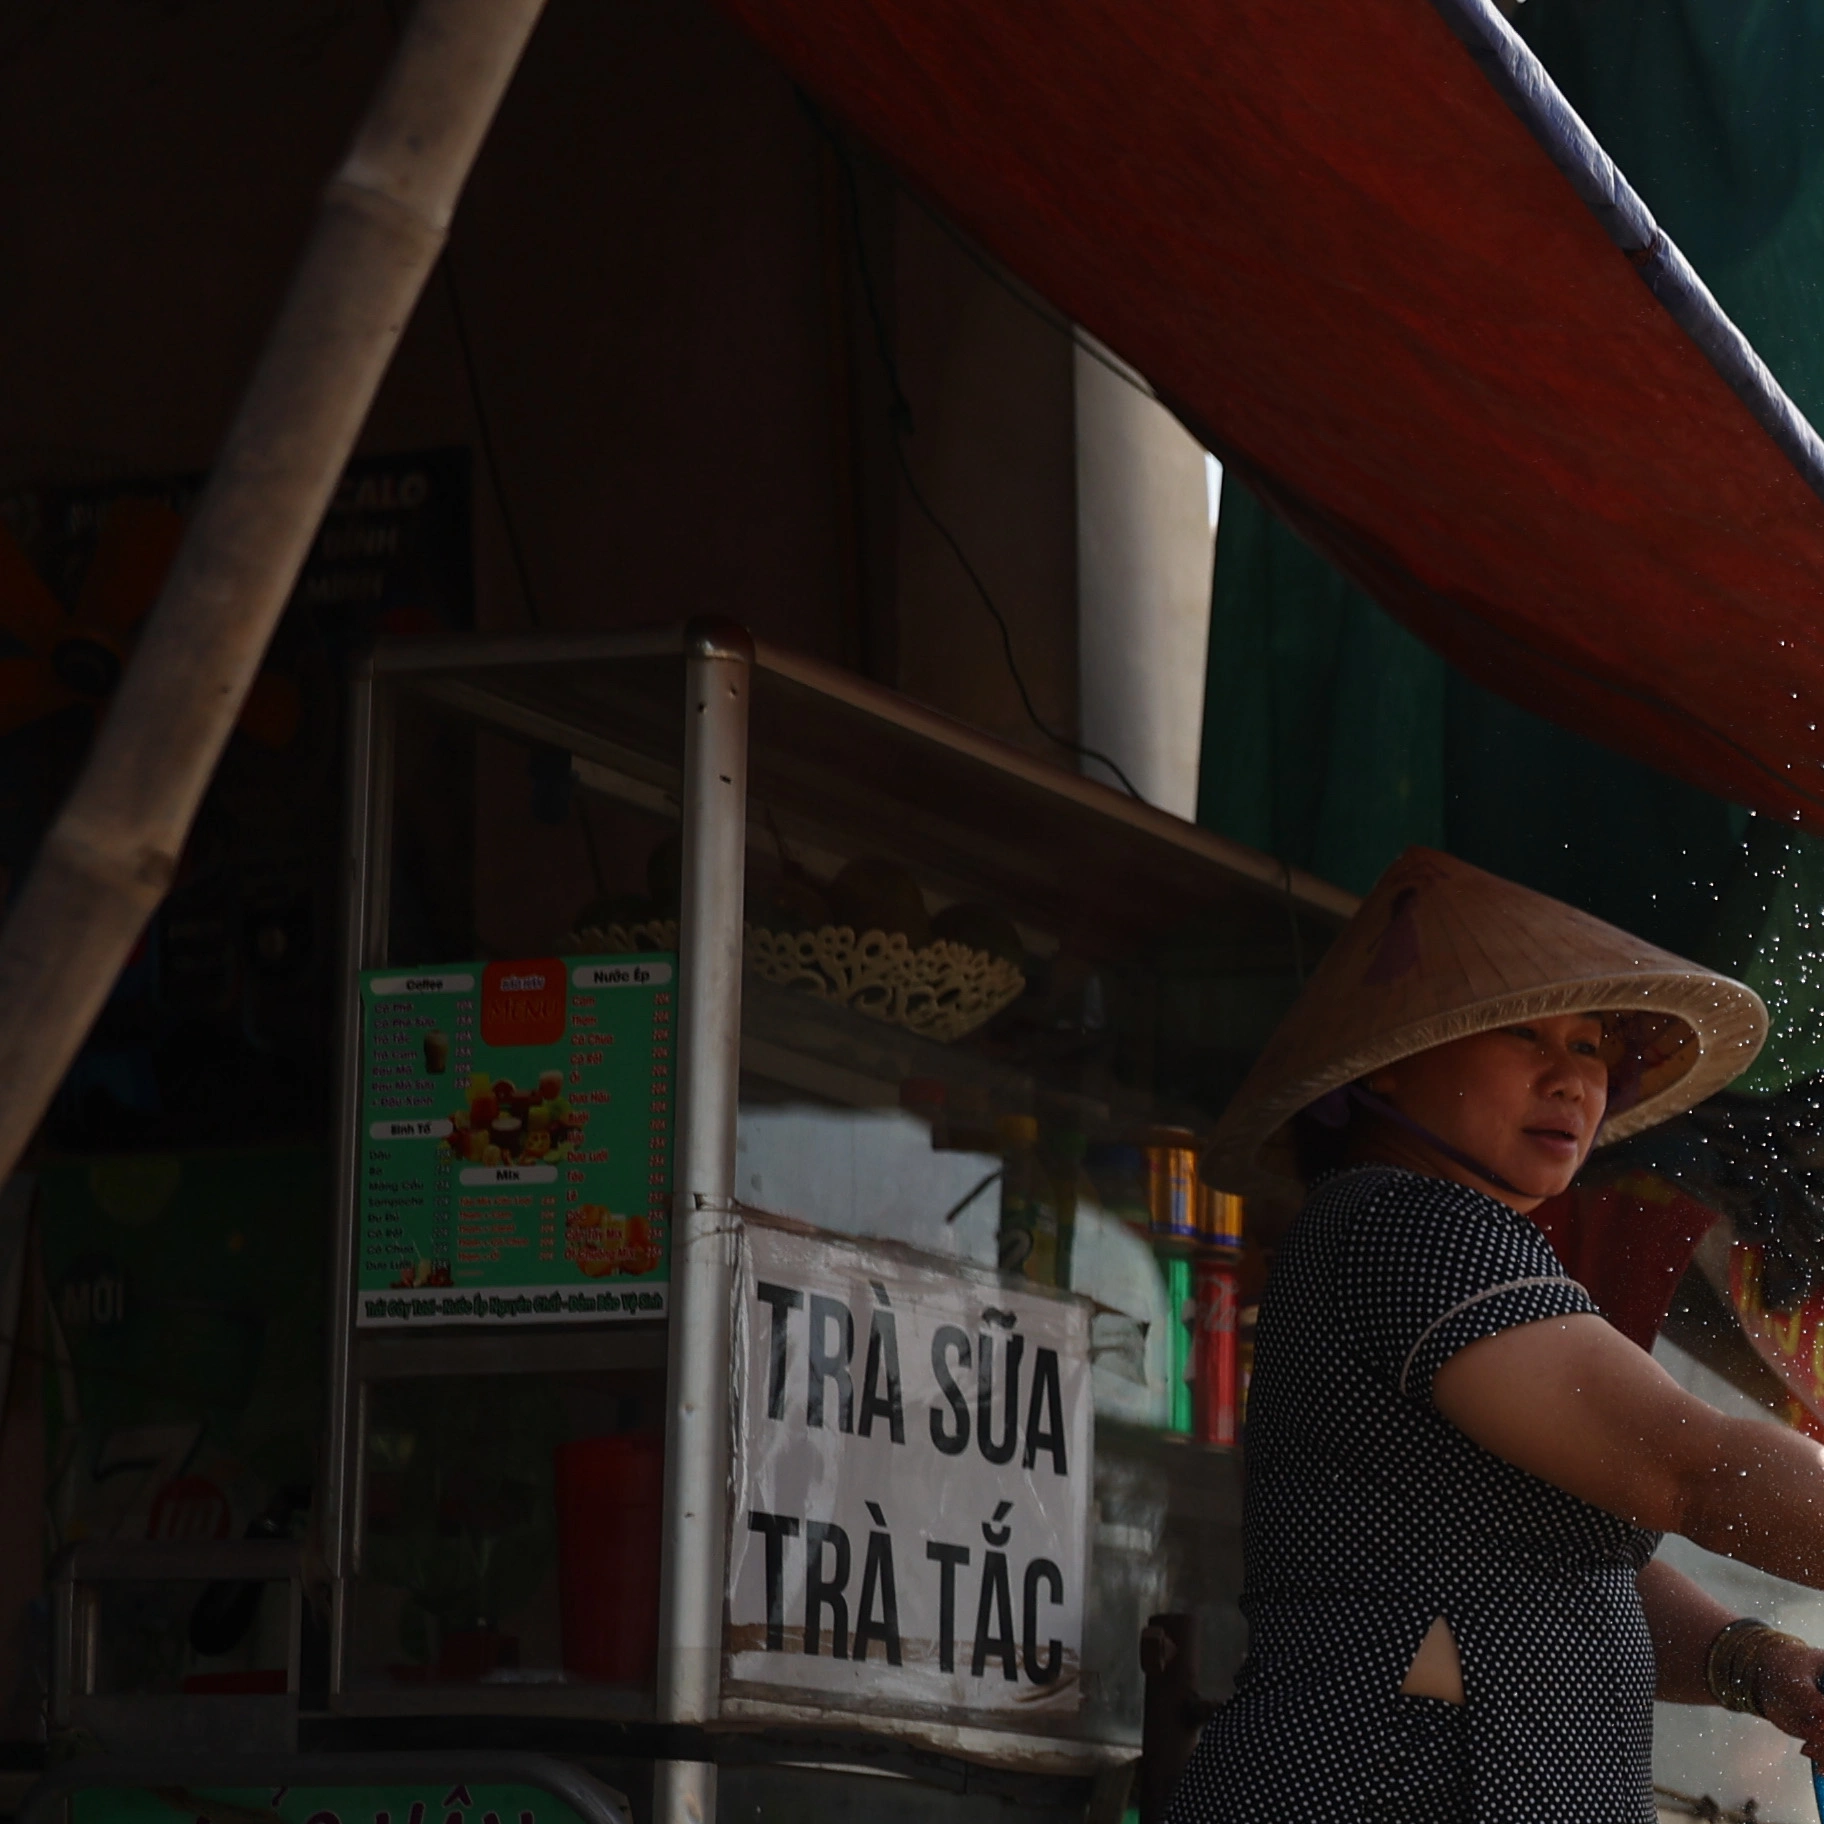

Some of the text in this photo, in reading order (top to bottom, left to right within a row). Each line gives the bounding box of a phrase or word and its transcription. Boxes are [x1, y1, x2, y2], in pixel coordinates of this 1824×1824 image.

[406, 980, 443, 990] Coffee
[594, 967, 650, 984] Nước Ép
[488, 995, 558, 1025] MENU
[496, 1170, 519, 1180] Mix
[756, 1279, 1069, 1477] TRÀ SỮA
[746, 1500, 1066, 1686] TRÀ TẮC
